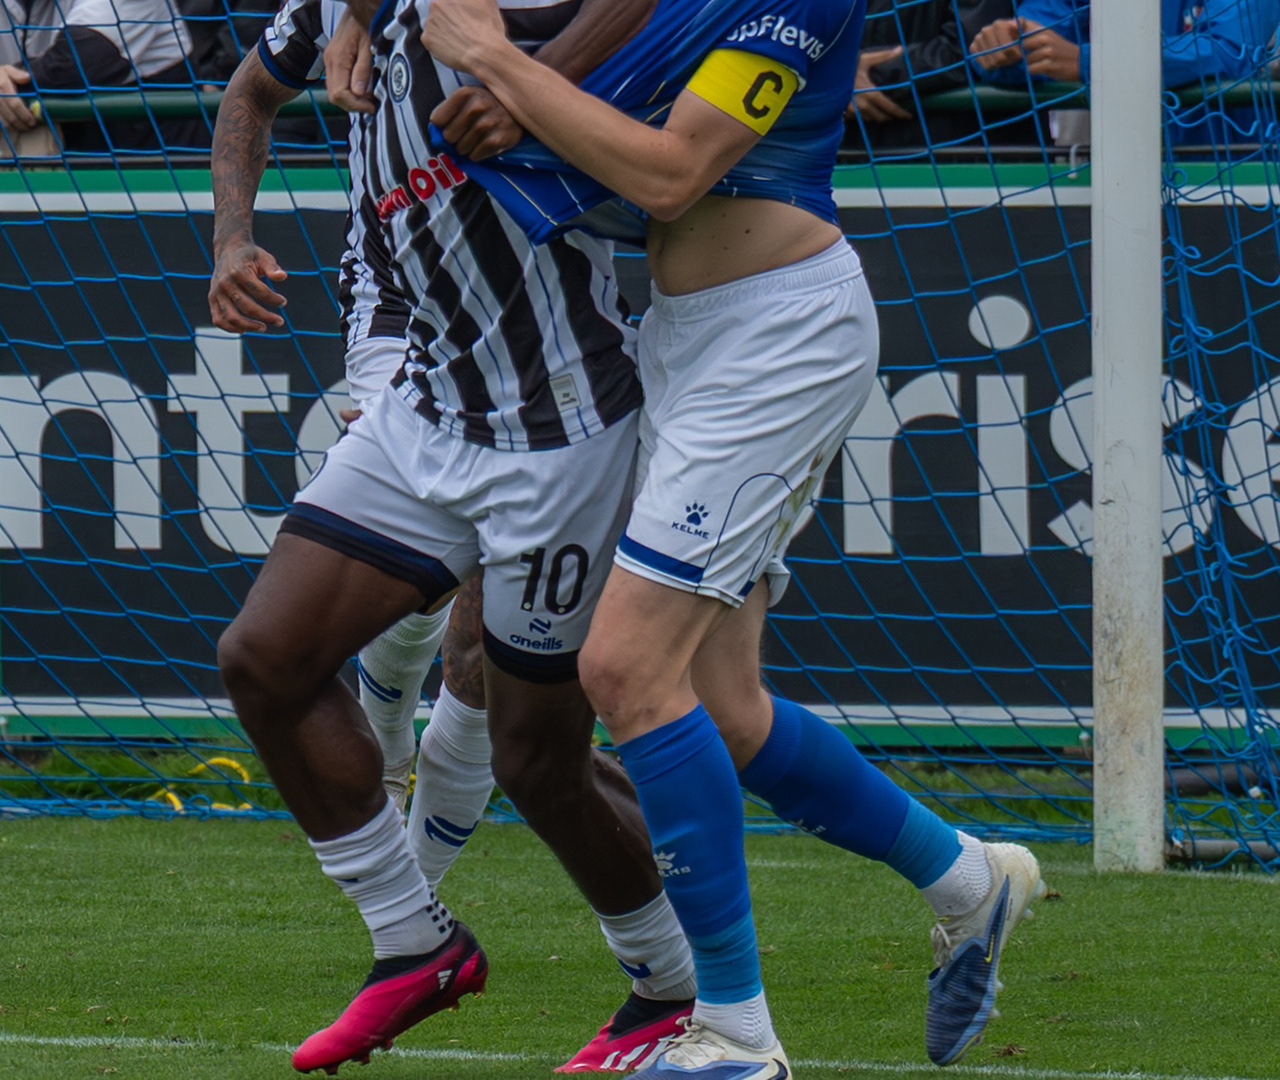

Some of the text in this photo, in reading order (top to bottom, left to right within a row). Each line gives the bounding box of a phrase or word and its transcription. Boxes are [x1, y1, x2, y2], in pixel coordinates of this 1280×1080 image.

[742, 70, 784, 120] C
[408, 152, 468, 202] Oil
[671, 521, 710, 540] KELME
[520, 543, 589, 616] 10
